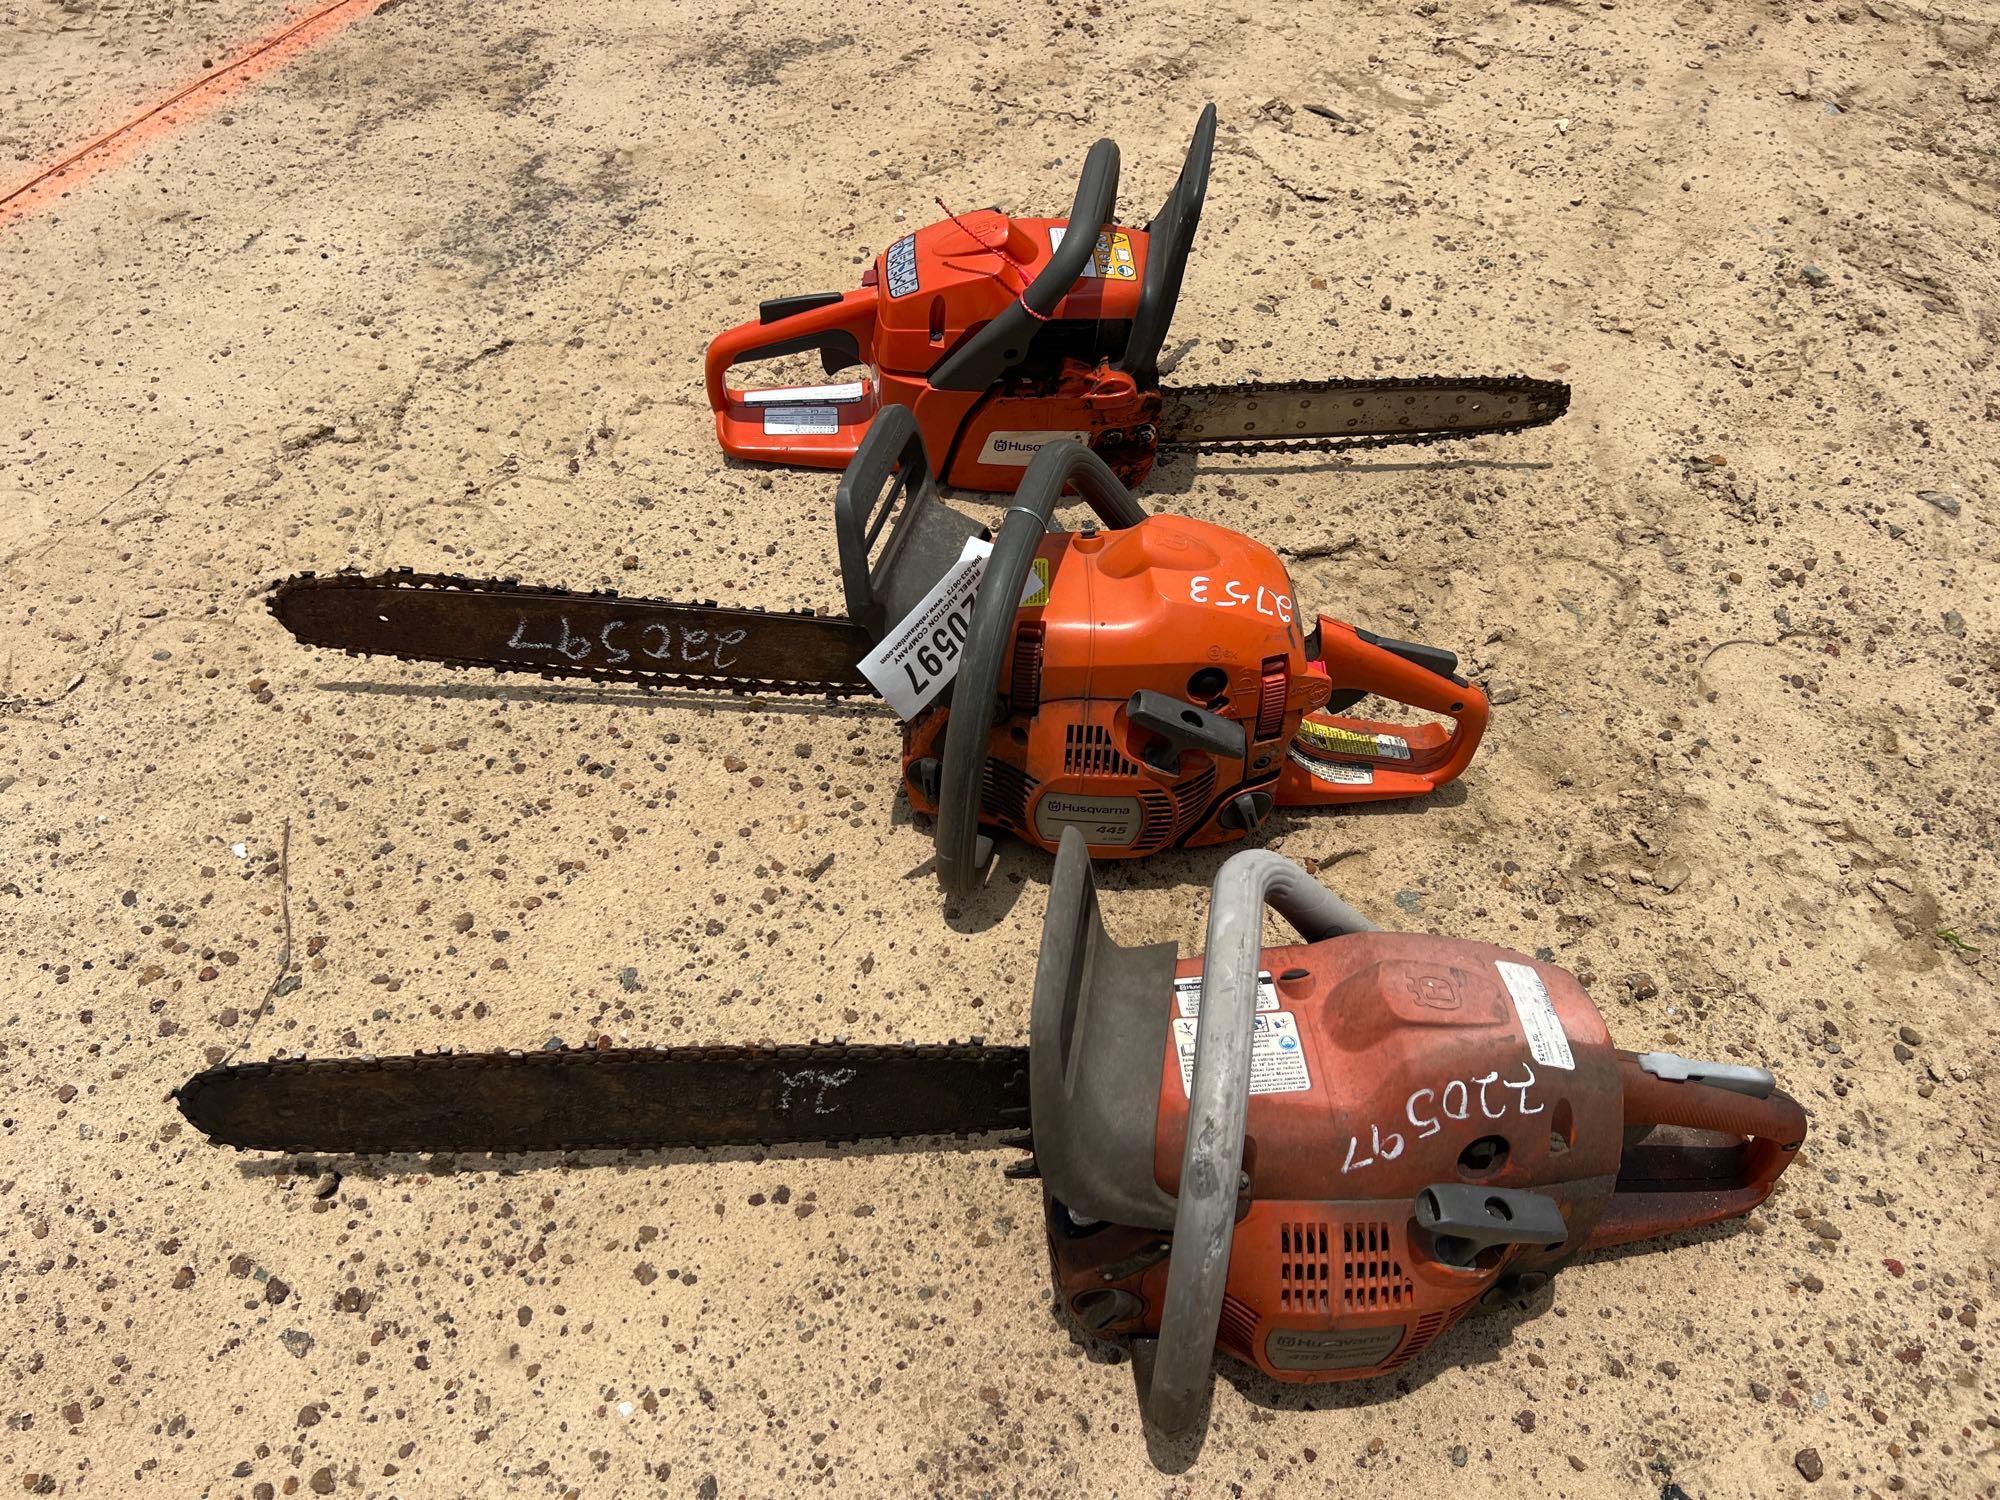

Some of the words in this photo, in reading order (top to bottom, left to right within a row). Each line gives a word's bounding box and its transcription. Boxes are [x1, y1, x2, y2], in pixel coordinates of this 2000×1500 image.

[957, 567, 981, 594] REBEL
[1189, 576, 1293, 623] 2753
[927, 592, 959, 629] AUCTION
[506, 615, 748, 670] 220597
[879, 597, 945, 665] www.rebelauction.com
[894, 625, 929, 665] COMPANY
[1061, 803, 1131, 815] Husqvarna
[1095, 825, 1129, 835] 445
